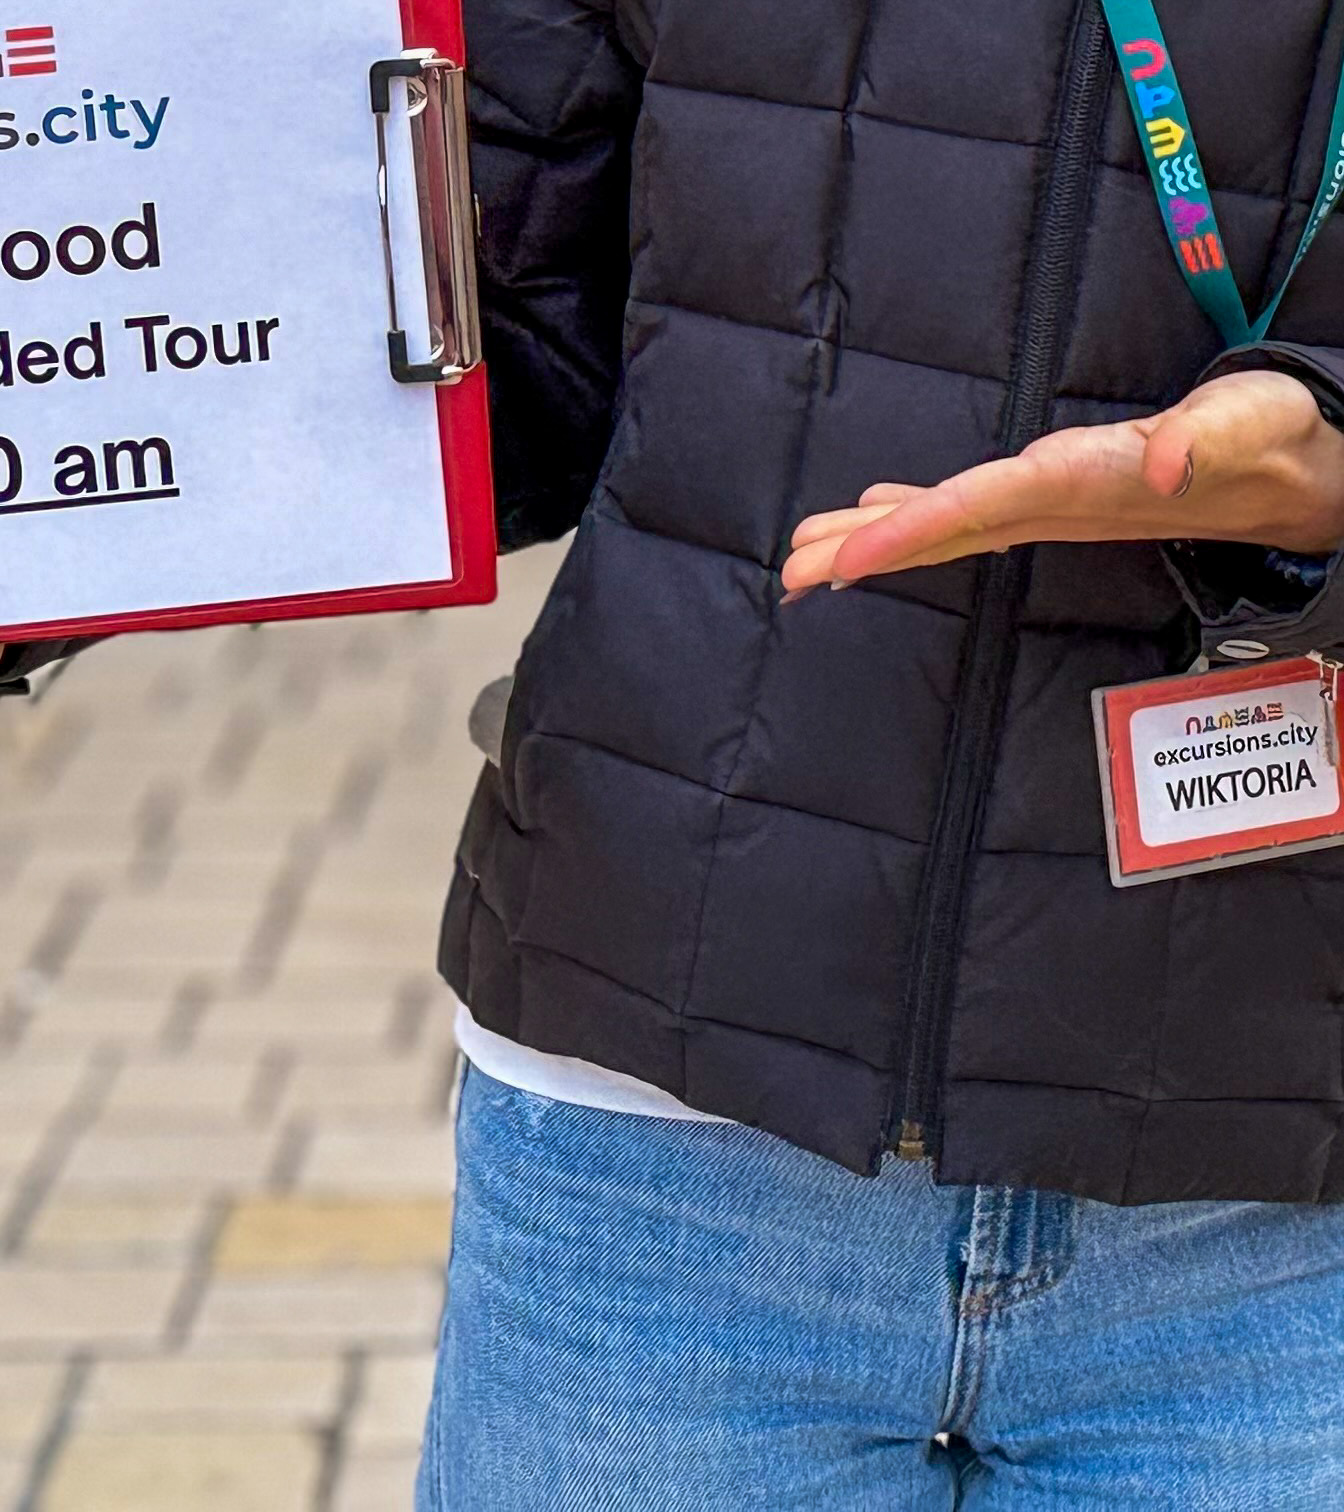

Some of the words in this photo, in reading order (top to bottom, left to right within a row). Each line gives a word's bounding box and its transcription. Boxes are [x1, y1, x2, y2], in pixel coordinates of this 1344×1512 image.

[124, 313, 280, 373] Tour
[53, 436, 175, 496] am
[1153, 722, 1319, 768] excursions.city
[1165, 758, 1318, 812] WIKTORIA
